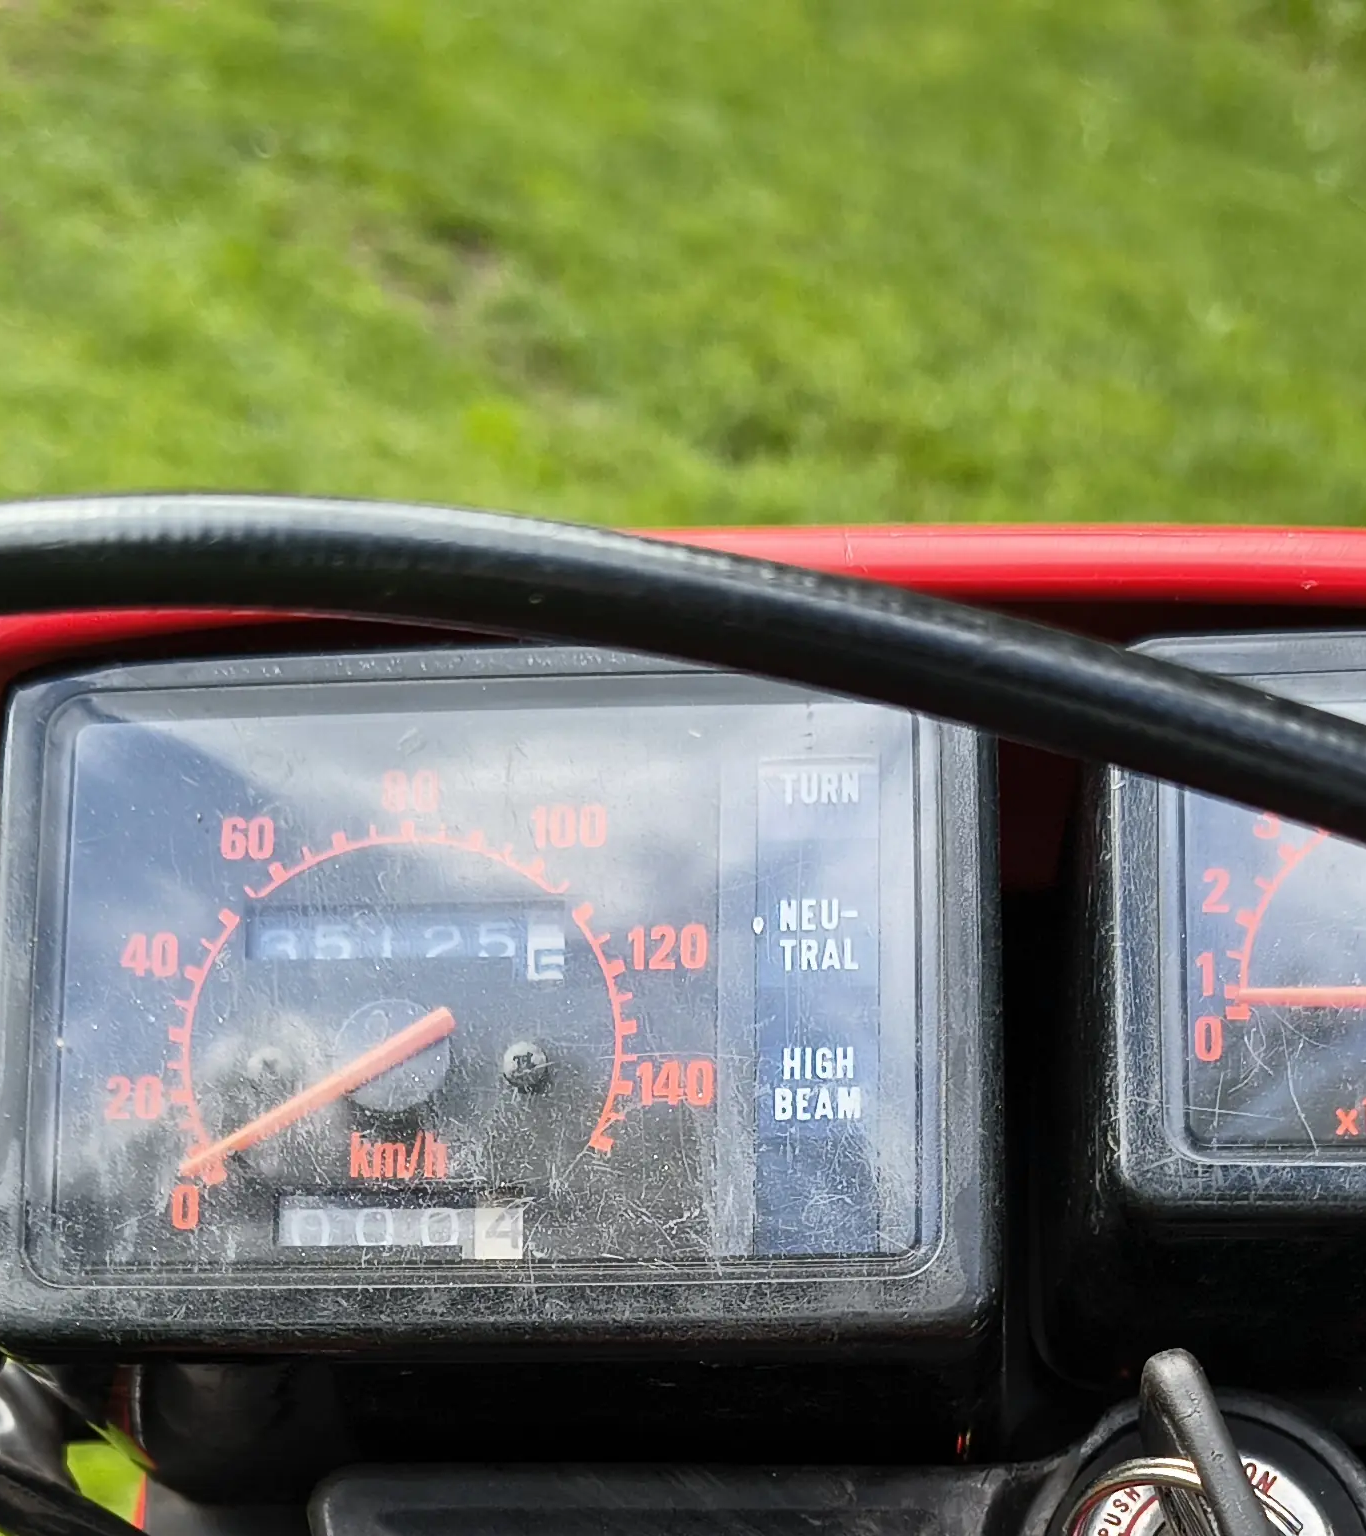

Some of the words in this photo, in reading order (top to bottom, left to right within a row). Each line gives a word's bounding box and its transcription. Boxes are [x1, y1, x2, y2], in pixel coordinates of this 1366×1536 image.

[382, 769, 440, 813] 80
[780, 771, 860, 805] TURN
[220, 816, 275, 861] 60
[531, 804, 608, 849] 100
[1202, 867, 1231, 913] 2
[779, 897, 859, 932] NEU-
[120, 932, 180, 978] 40
[627, 923, 710, 971] 120
[779, 937, 860, 972] TRAL
[1194, 952, 1215, 997] 1
[1194, 1015, 1223, 1062] 0
[637, 1058, 716, 1107] 140
[782, 1046, 855, 1080] HIGH
[104, 1075, 163, 1120] 20
[773, 1086, 863, 1121] BEAM
[349, 1130, 448, 1180] km/h
[171, 1184, 200, 1230] 0
[1243, 1462, 1278, 1494] ON
